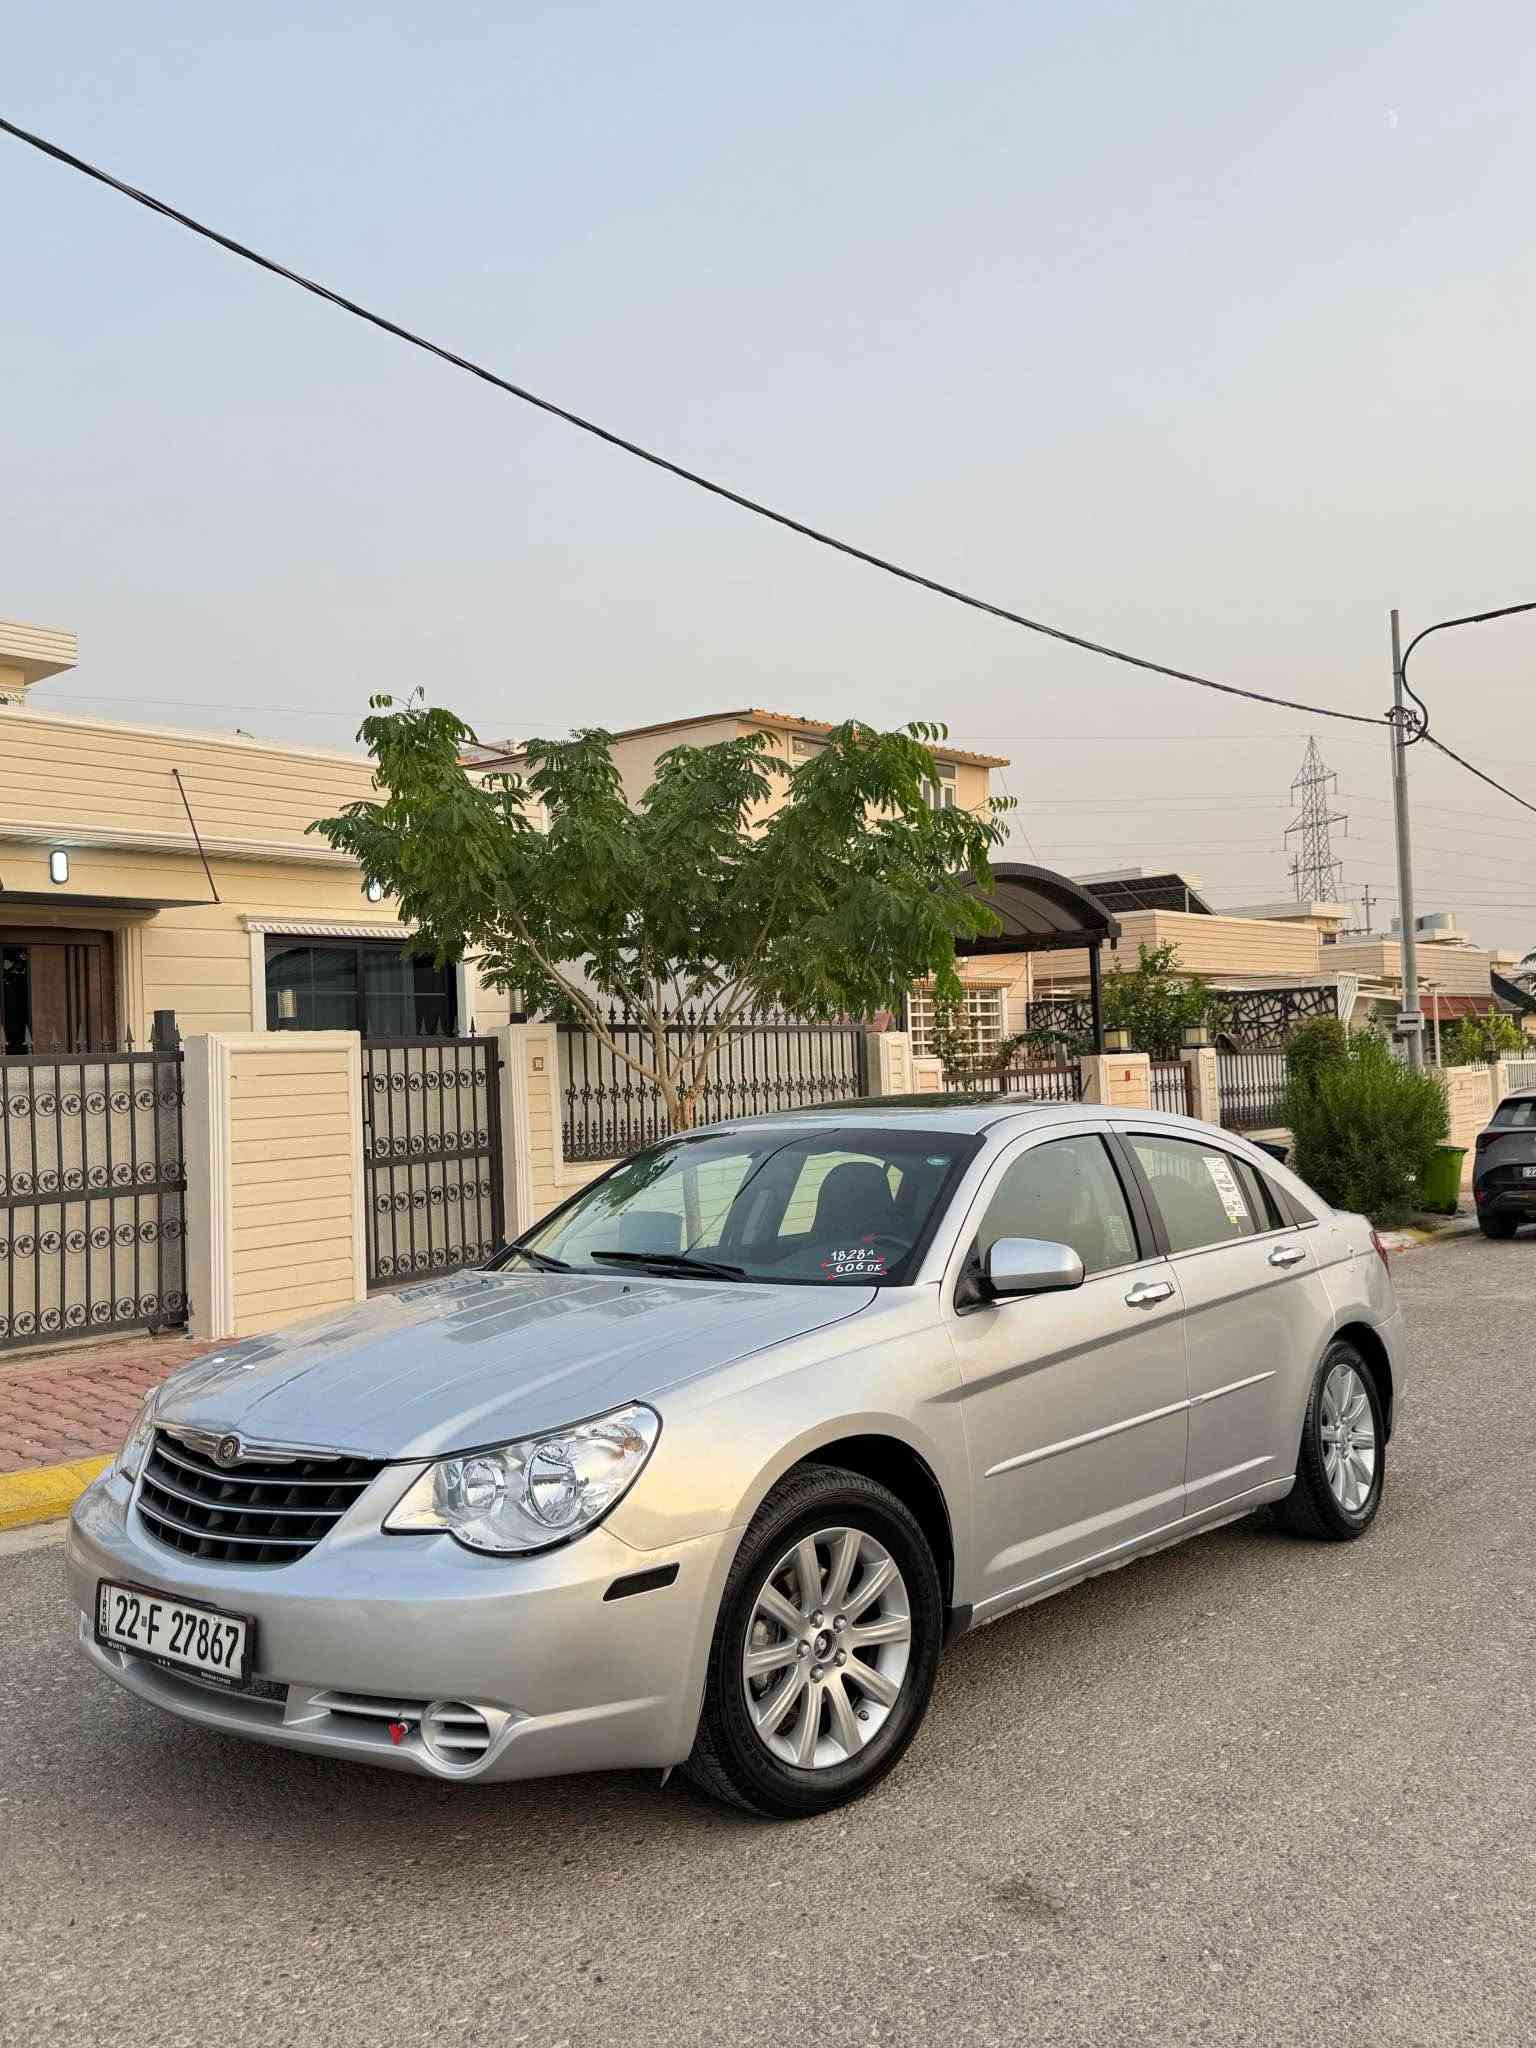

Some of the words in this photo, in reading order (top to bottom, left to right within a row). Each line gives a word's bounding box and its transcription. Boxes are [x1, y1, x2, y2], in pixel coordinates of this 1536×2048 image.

[836, 1262, 864, 1273] 606
[114, 1595, 140, 1640] 22
[147, 1604, 162, 1645] F
[169, 1610, 239, 1669] 27867
